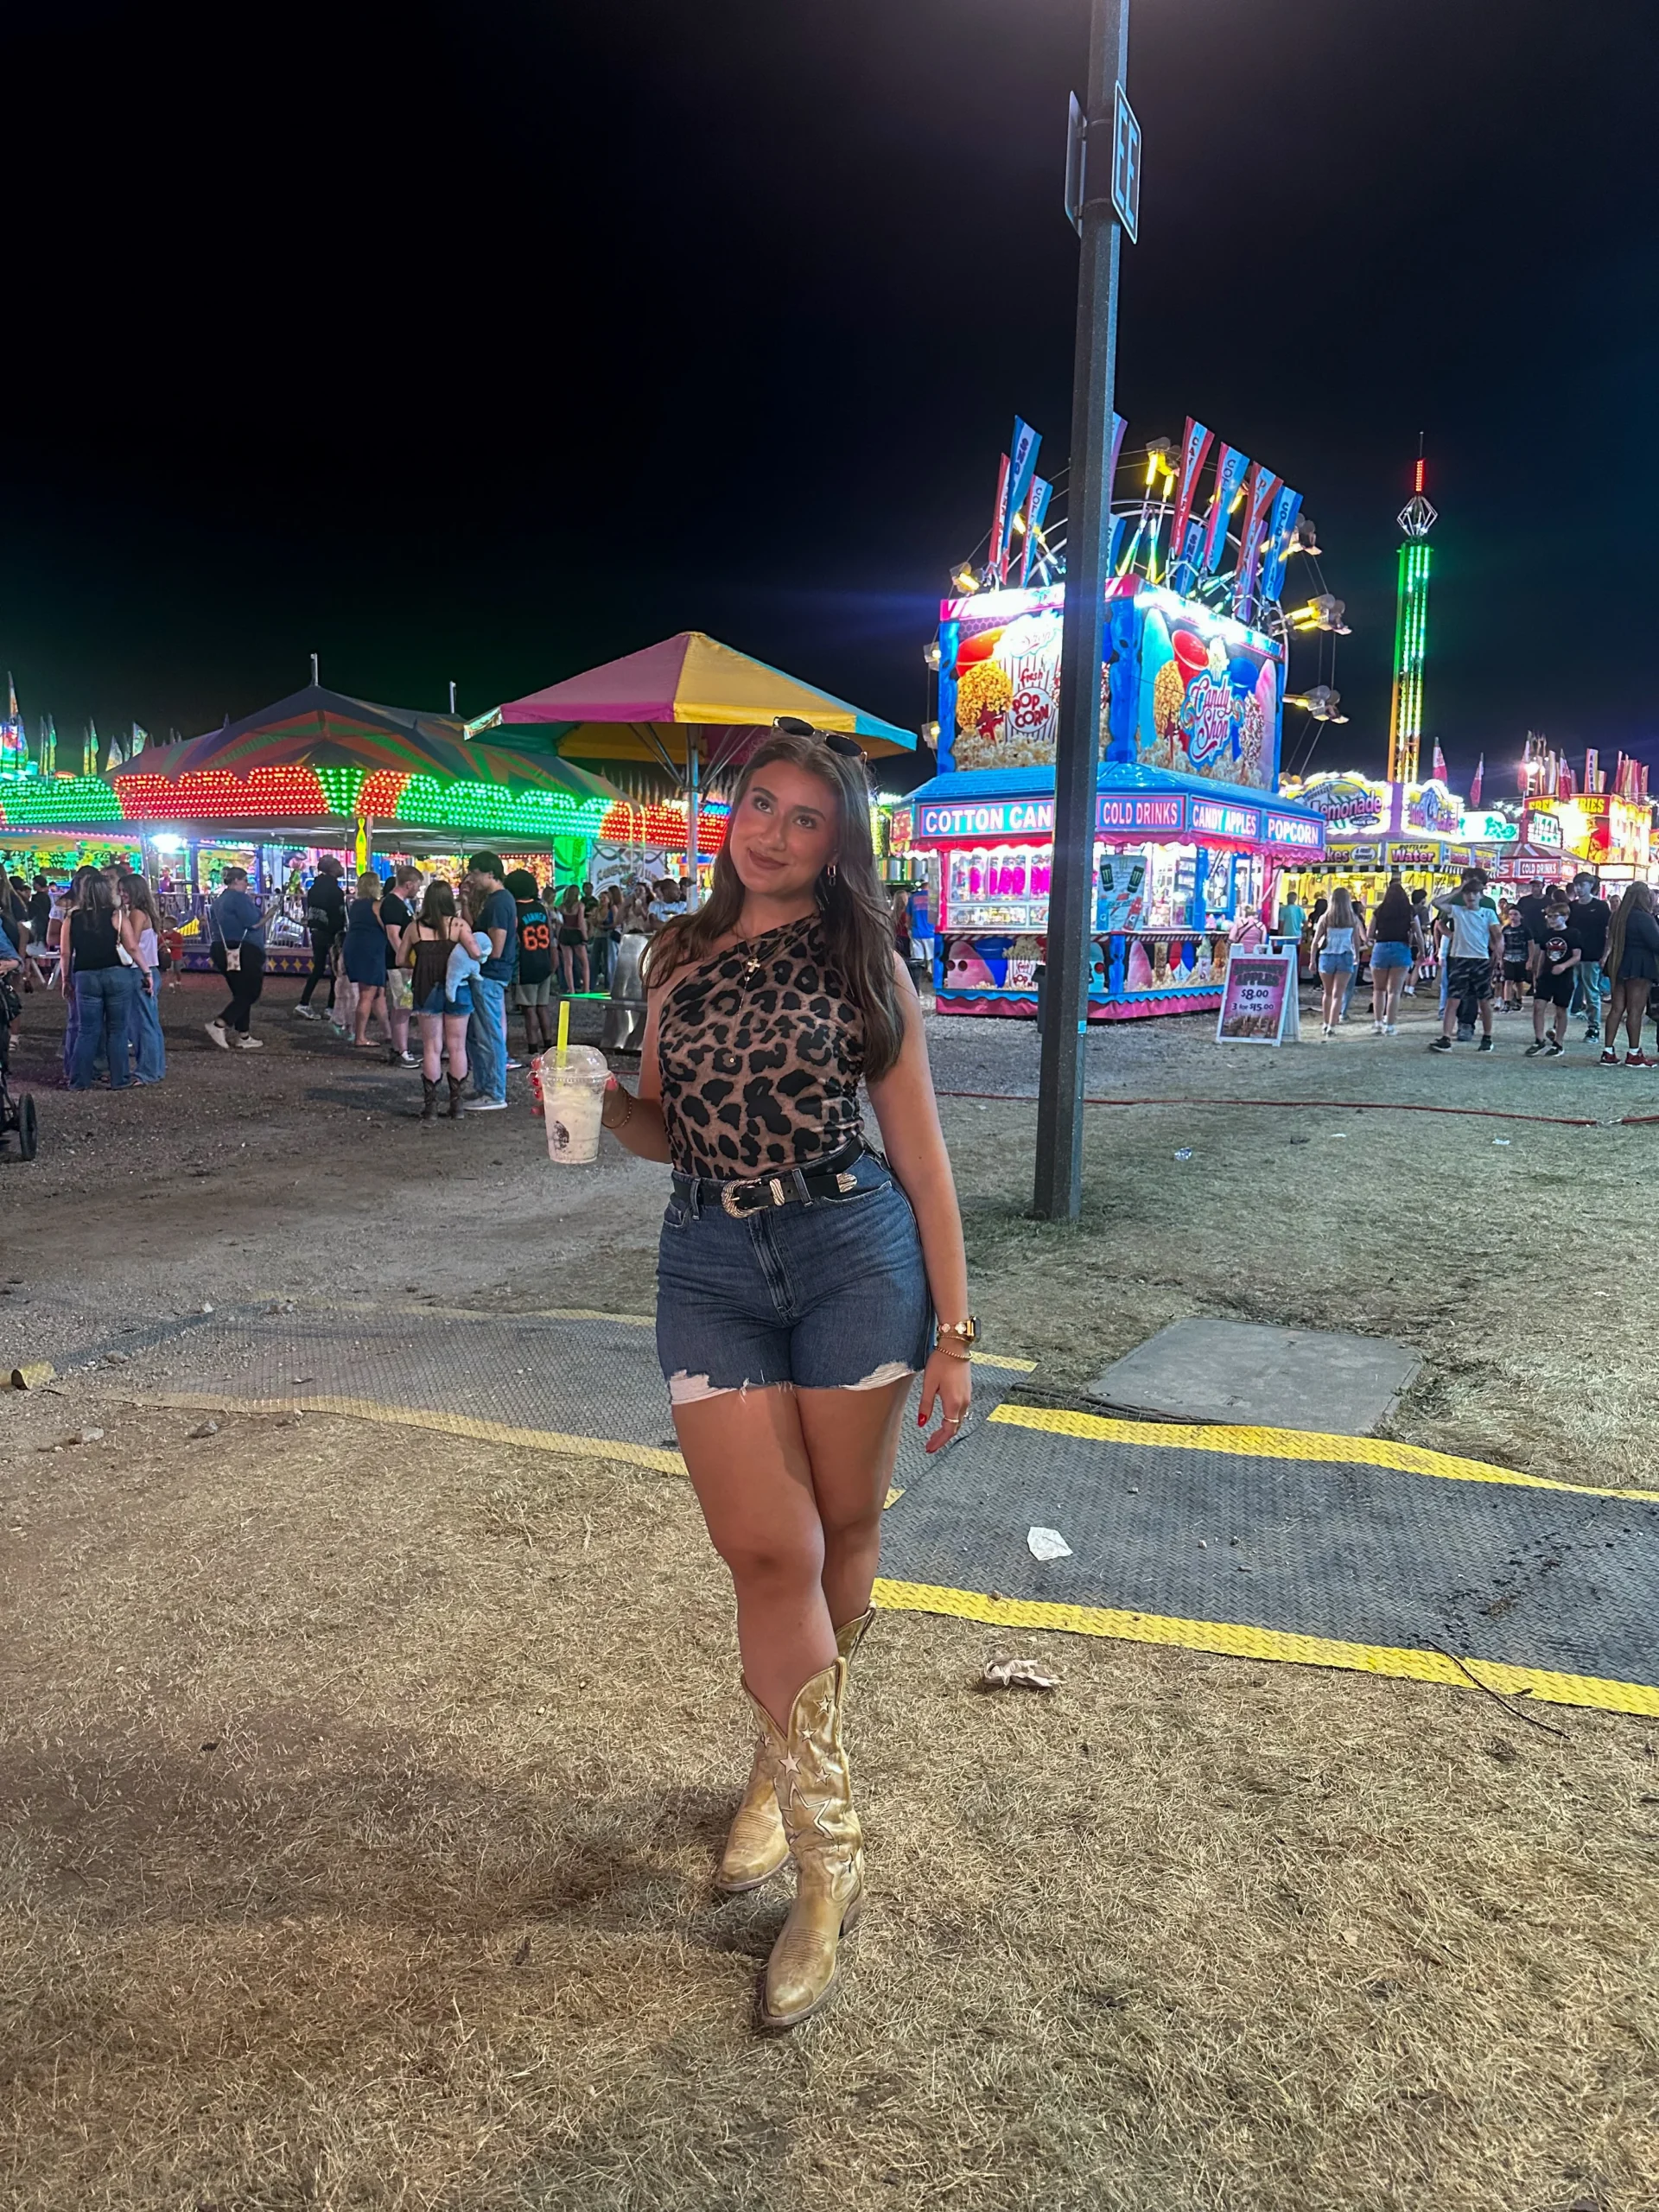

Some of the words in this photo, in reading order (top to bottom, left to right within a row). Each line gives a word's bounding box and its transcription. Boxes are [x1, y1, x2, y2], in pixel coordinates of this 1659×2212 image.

[1020, 668, 1043, 683] fresh
[1012, 692, 1040, 715] POP
[1192, 677, 1233, 720] Candy
[1015, 703, 1049, 728] CORN
[1196, 709, 1230, 750] Shop
[1103, 802, 1133, 825] COLD
[1135, 802, 1178, 826] DRINKS
[1579, 798, 1605, 813] RIES
[925, 807, 1003, 833] COTTON
[1009, 804, 1052, 830] CAN
[1192, 804, 1224, 831] CANDY
[1224, 809, 1256, 836] APPLES
[1268, 819, 1319, 845] POPCORN
[1326, 846, 1349, 862] kes
[1391, 849, 1434, 863] Water
[1522, 863, 1535, 874] COLD
[1536, 863, 1556, 874] DRINKS
[522, 924, 550, 950] 69
[1241, 988, 1269, 1000] $8.00
[1249, 1002, 1274, 1012] $15.00
